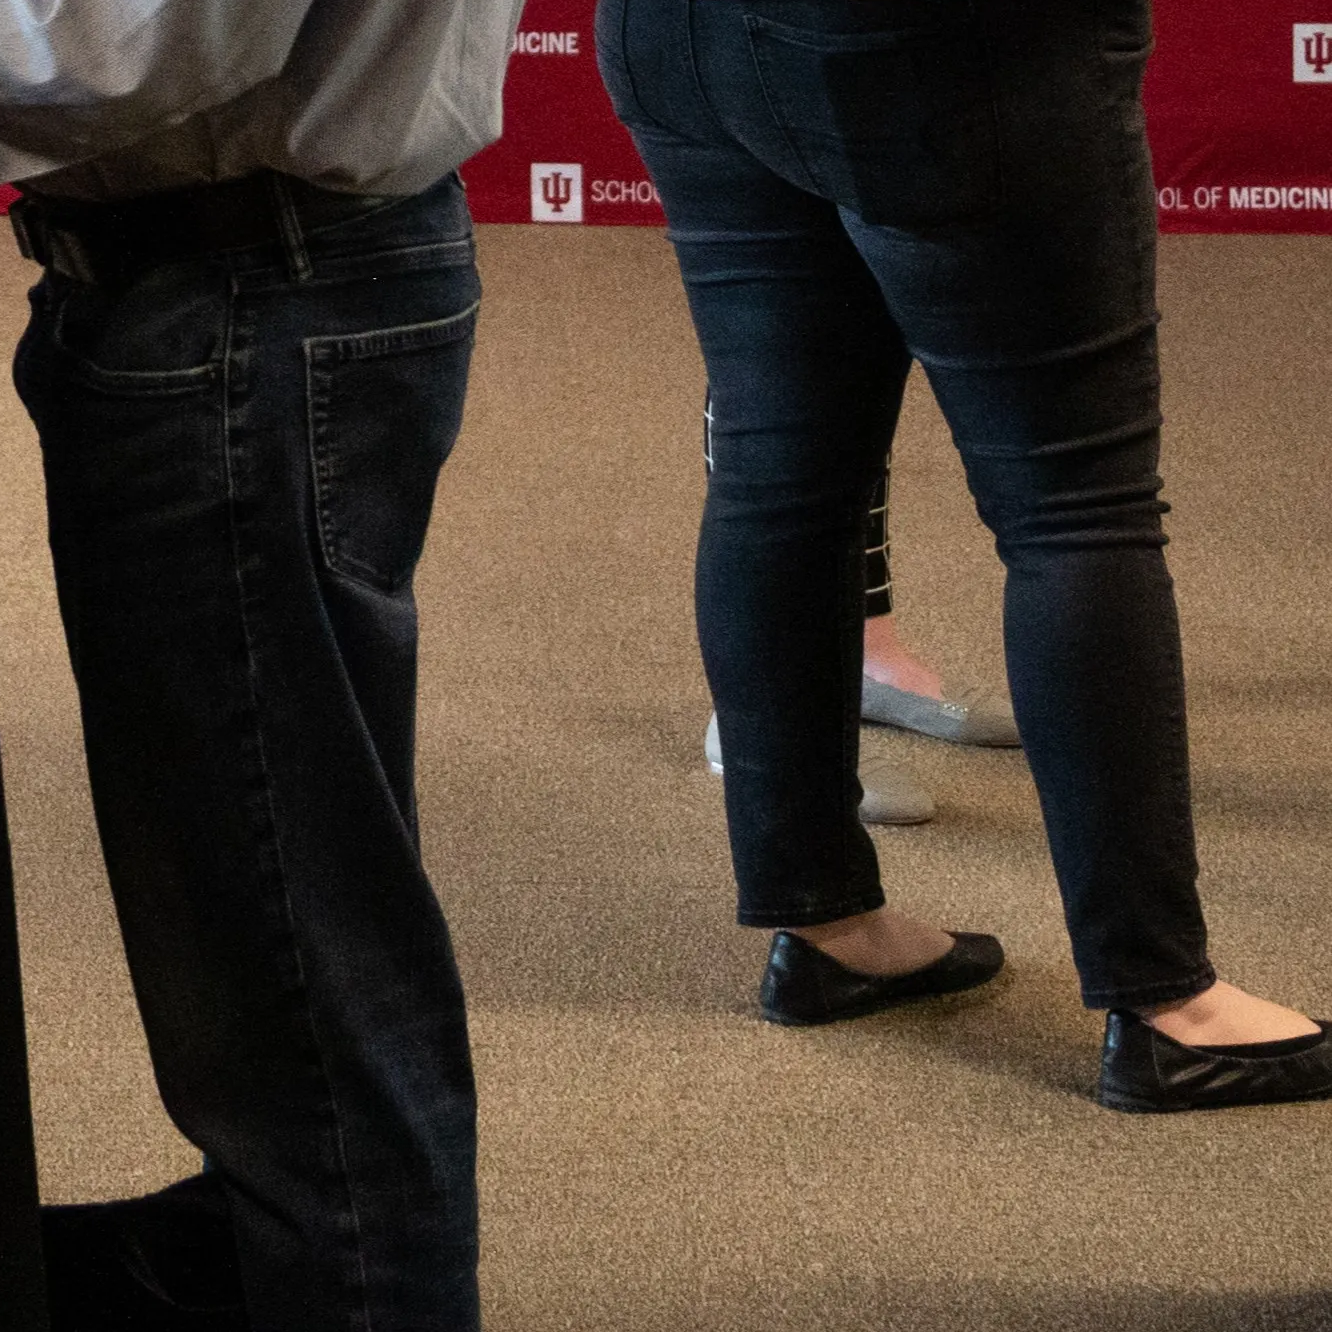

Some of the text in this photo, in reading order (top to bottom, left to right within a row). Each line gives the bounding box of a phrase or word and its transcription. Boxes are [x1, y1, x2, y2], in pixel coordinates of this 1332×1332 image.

[517, 31, 580, 55] ICINE
[590, 179, 661, 204] SCHO
[1193, 185, 1223, 210] OF
[1228, 185, 1332, 210] MEDICIN
